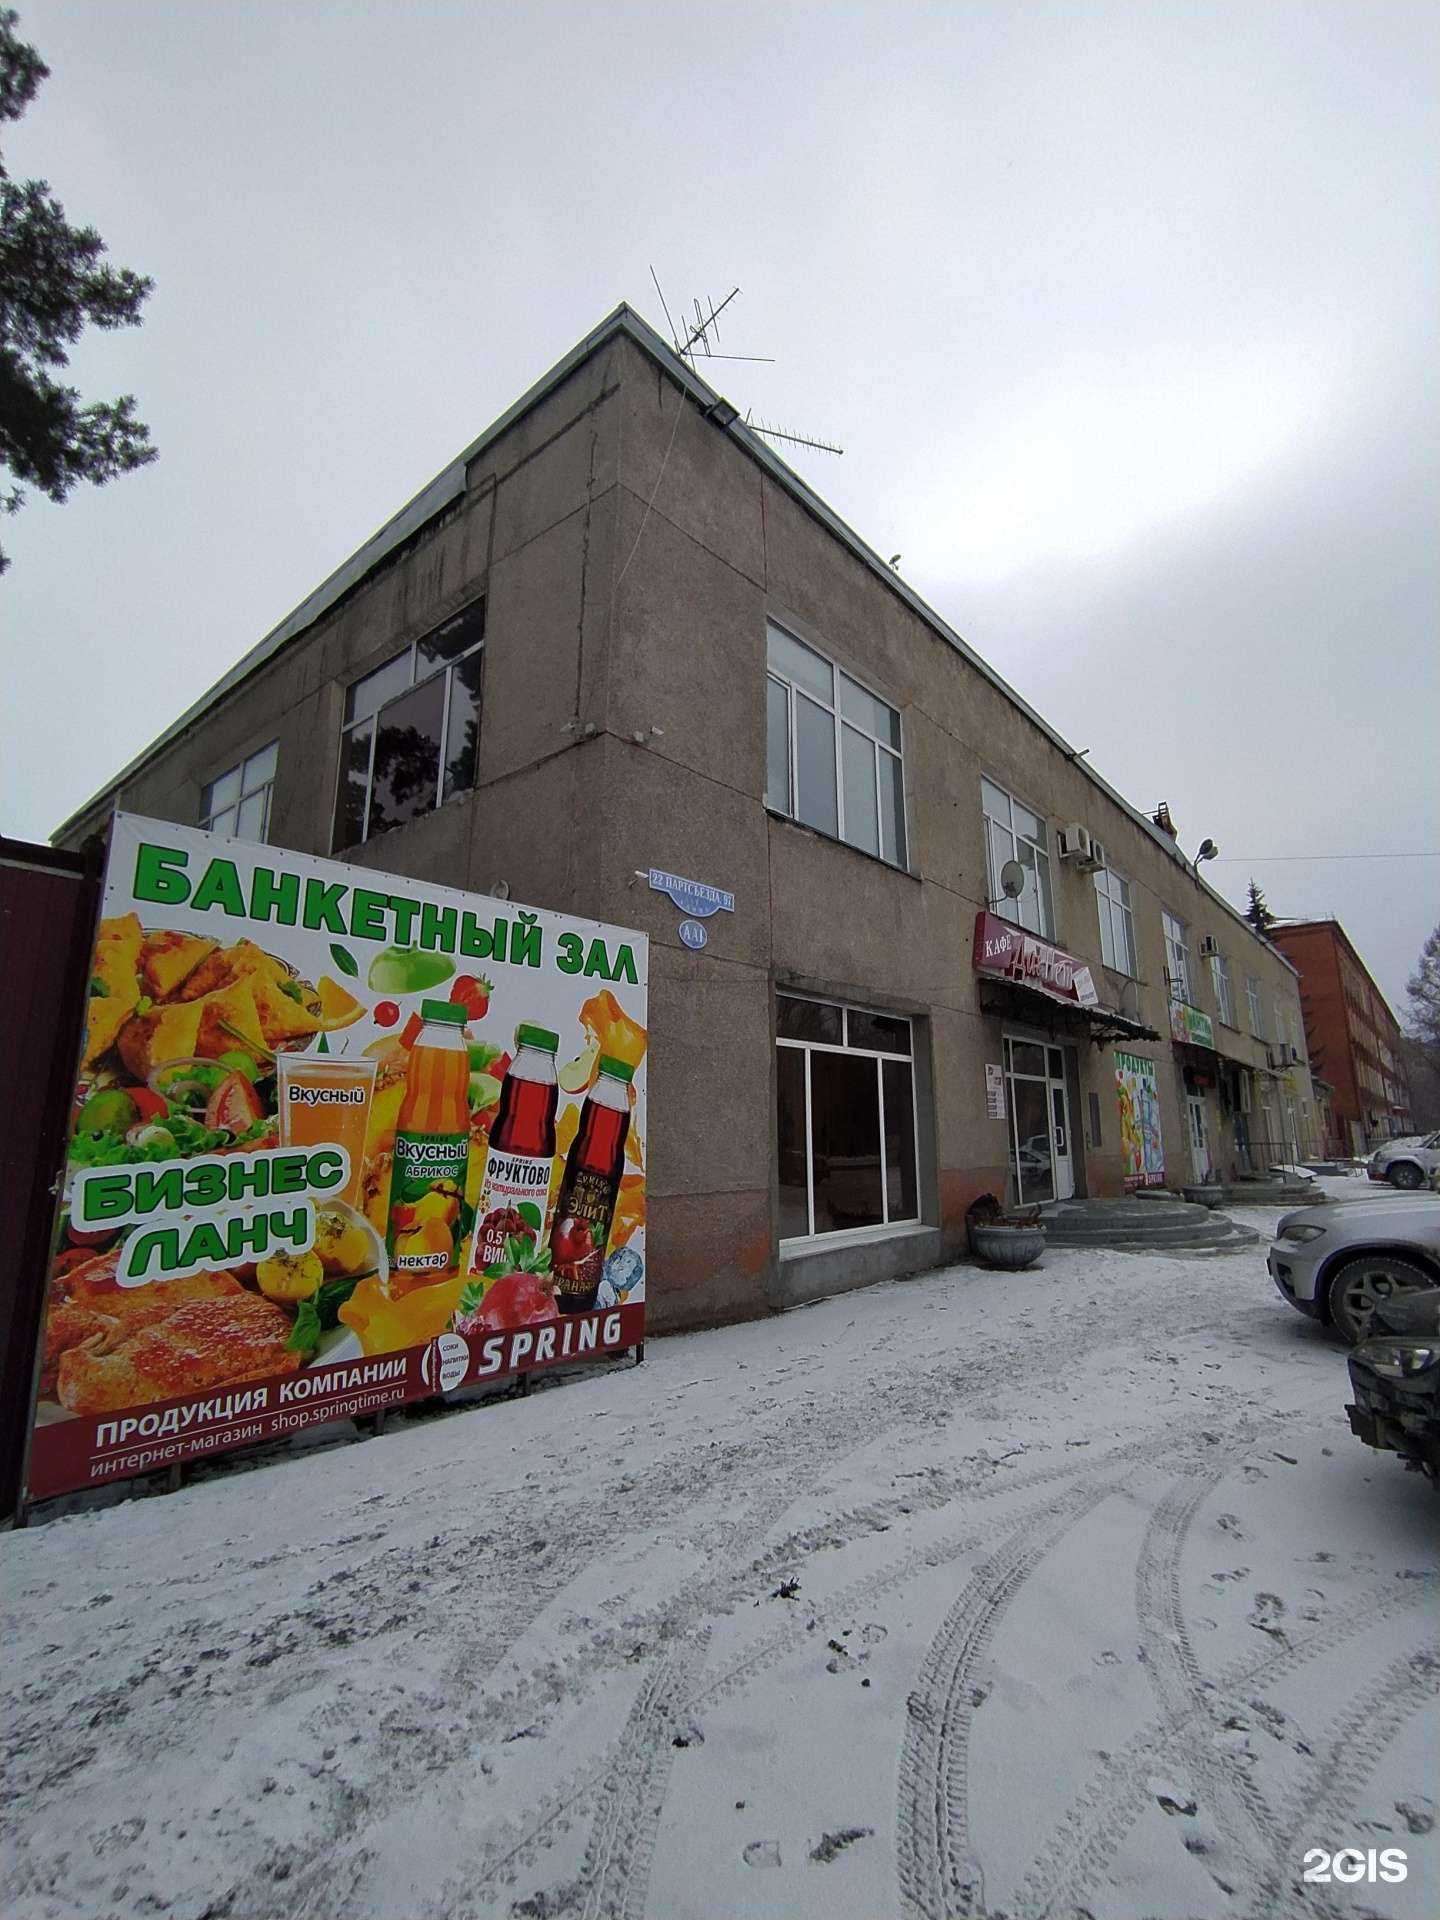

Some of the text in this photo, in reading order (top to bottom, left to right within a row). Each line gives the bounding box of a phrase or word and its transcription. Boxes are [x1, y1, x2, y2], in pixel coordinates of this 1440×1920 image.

[133, 842, 639, 985] БАНКЕТНЫЙ ЗАЛ
[985, 934, 1013, 957] КАФЕ
[289, 1086, 364, 1105] Вкусный
[397, 1138, 468, 1161] Вкусный
[406, 1166, 459, 1177] АБРИКОС
[488, 1157, 550, 1185] ФРУКТОВО
[84, 1151, 344, 1221] БИЗНЕС
[127, 1207, 308, 1278] ЛАНЧ
[399, 1254, 447, 1268] нектар
[479, 1313, 621, 1375] SPRING
[96, 1387, 267, 1447] ПРОДУКЦИЯ
[279, 1356, 407, 1403] КОМПАНИИ
[90, 1386, 405, 1477] интернет-магазин shop.springtime.ru
